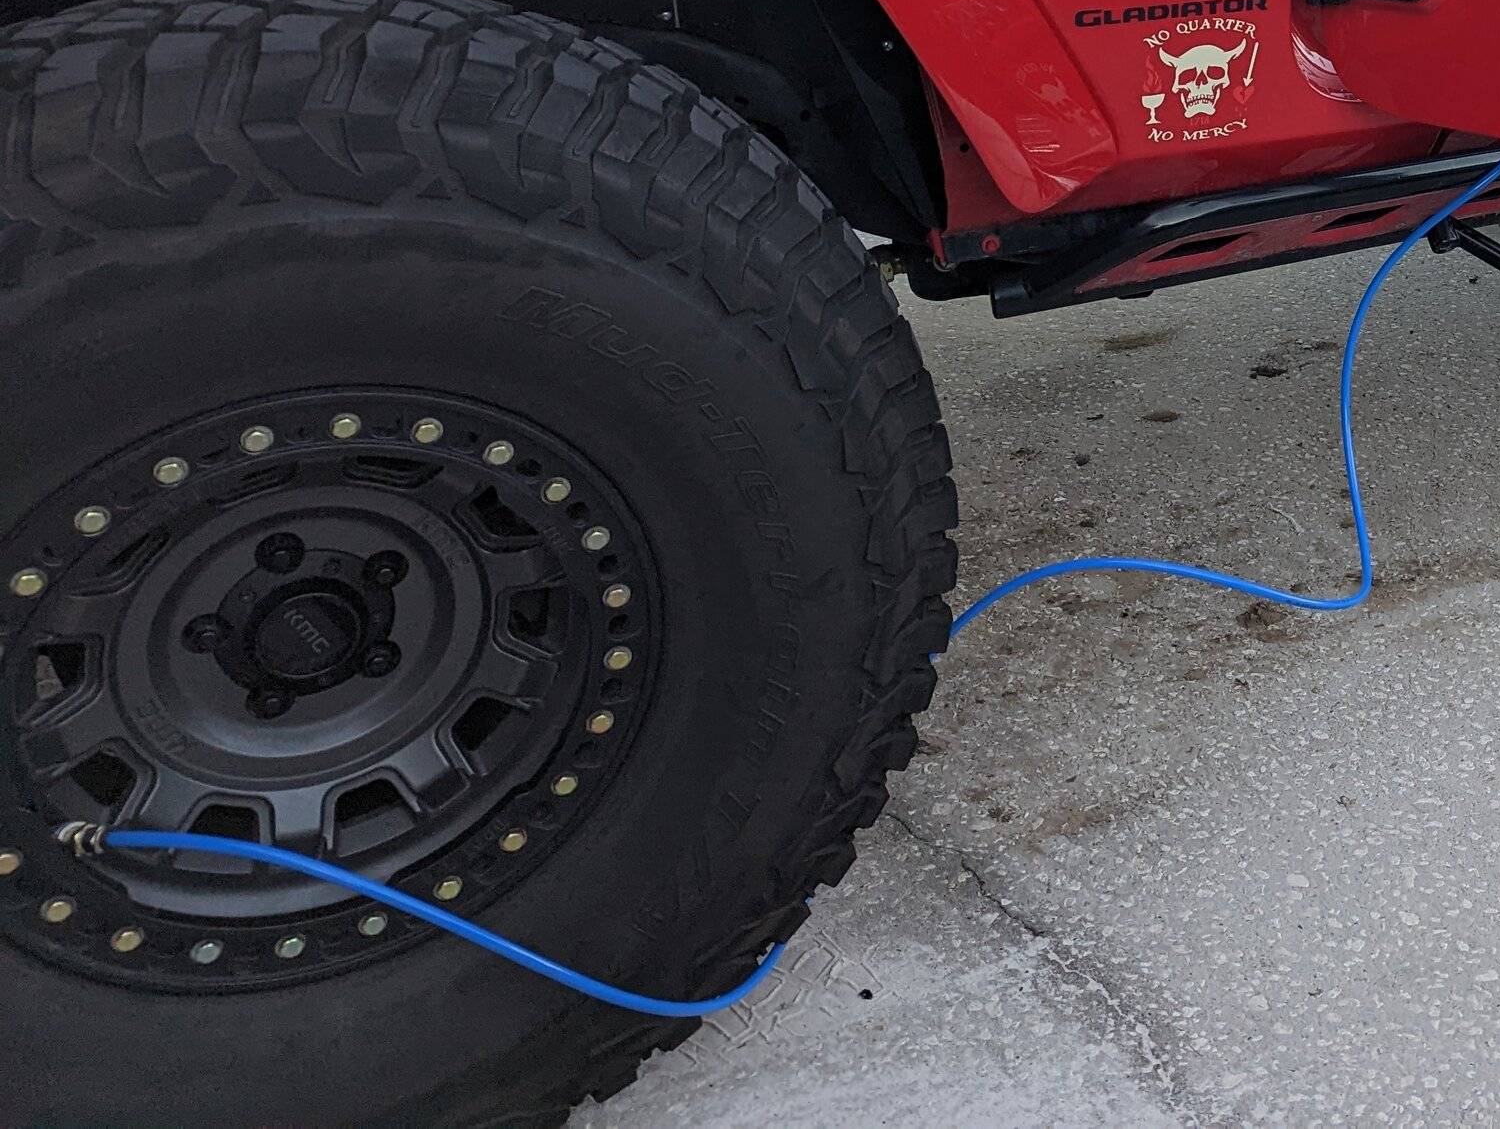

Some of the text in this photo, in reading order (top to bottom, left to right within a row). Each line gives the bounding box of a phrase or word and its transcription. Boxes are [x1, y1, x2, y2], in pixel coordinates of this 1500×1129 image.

[1143, 17, 1257, 48] NO QUARTER
[1147, 118, 1249, 143] NO MERCY
